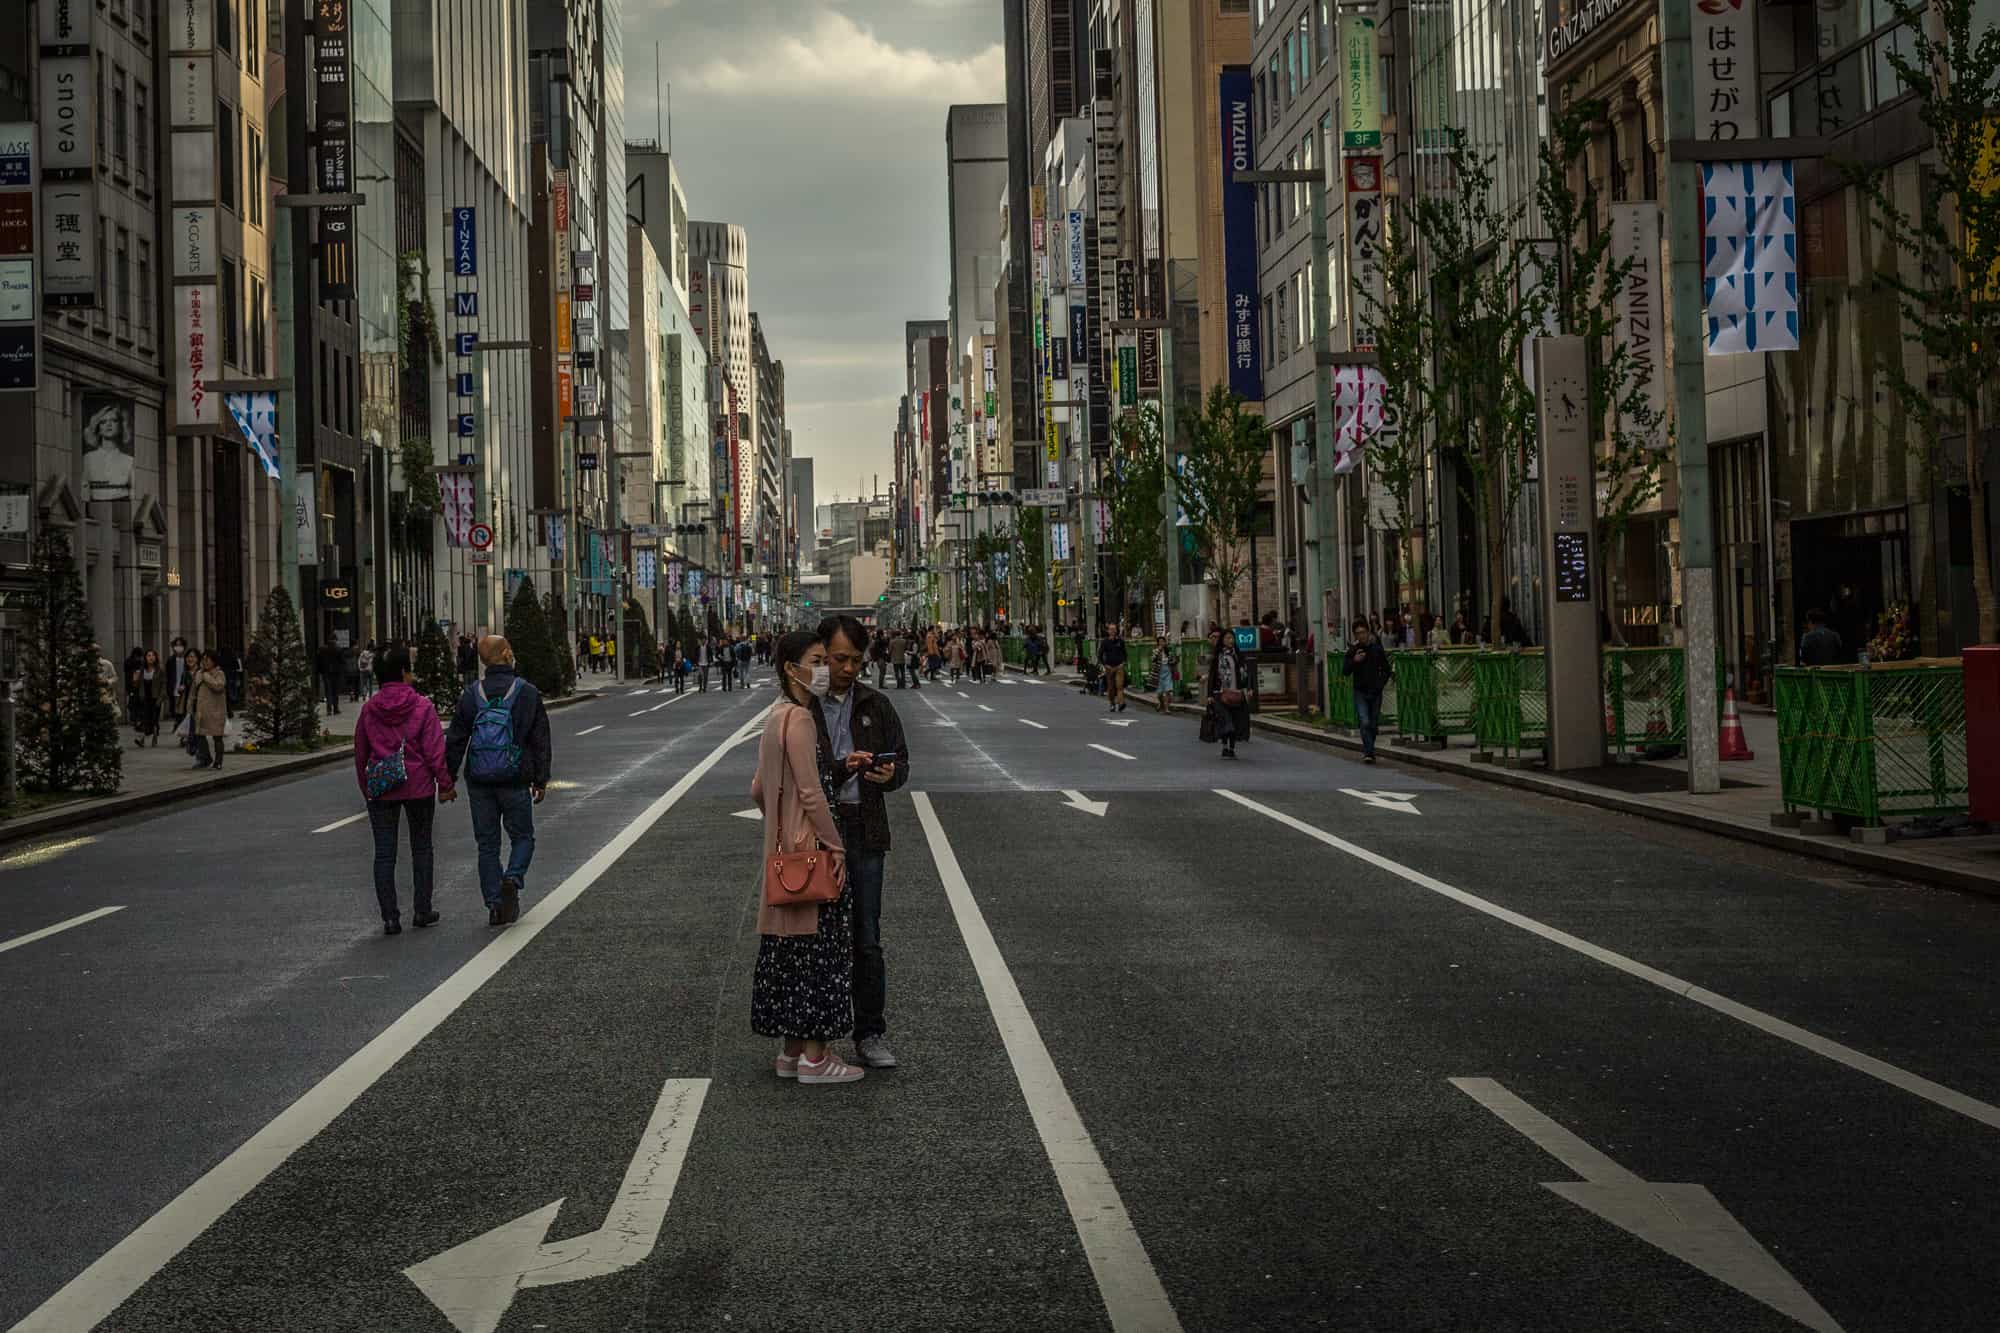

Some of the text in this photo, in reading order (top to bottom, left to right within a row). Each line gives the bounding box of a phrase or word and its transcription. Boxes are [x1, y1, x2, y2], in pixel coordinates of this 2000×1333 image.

[1551, 10, 1588, 59] GINZA
[1707, 26, 1739, 140] はせがわ
[1231, 100, 1247, 171] MIZUHO
[1354, 133, 1371, 145] 3F
[327, 222, 346, 232] UGG
[1234, 294, 1252, 369] みずほ銀行
[1628, 257, 1656, 388] TANIZAWA
[188, 332, 204, 420] 銀座アスター
[325, 587, 348, 599] UGG
